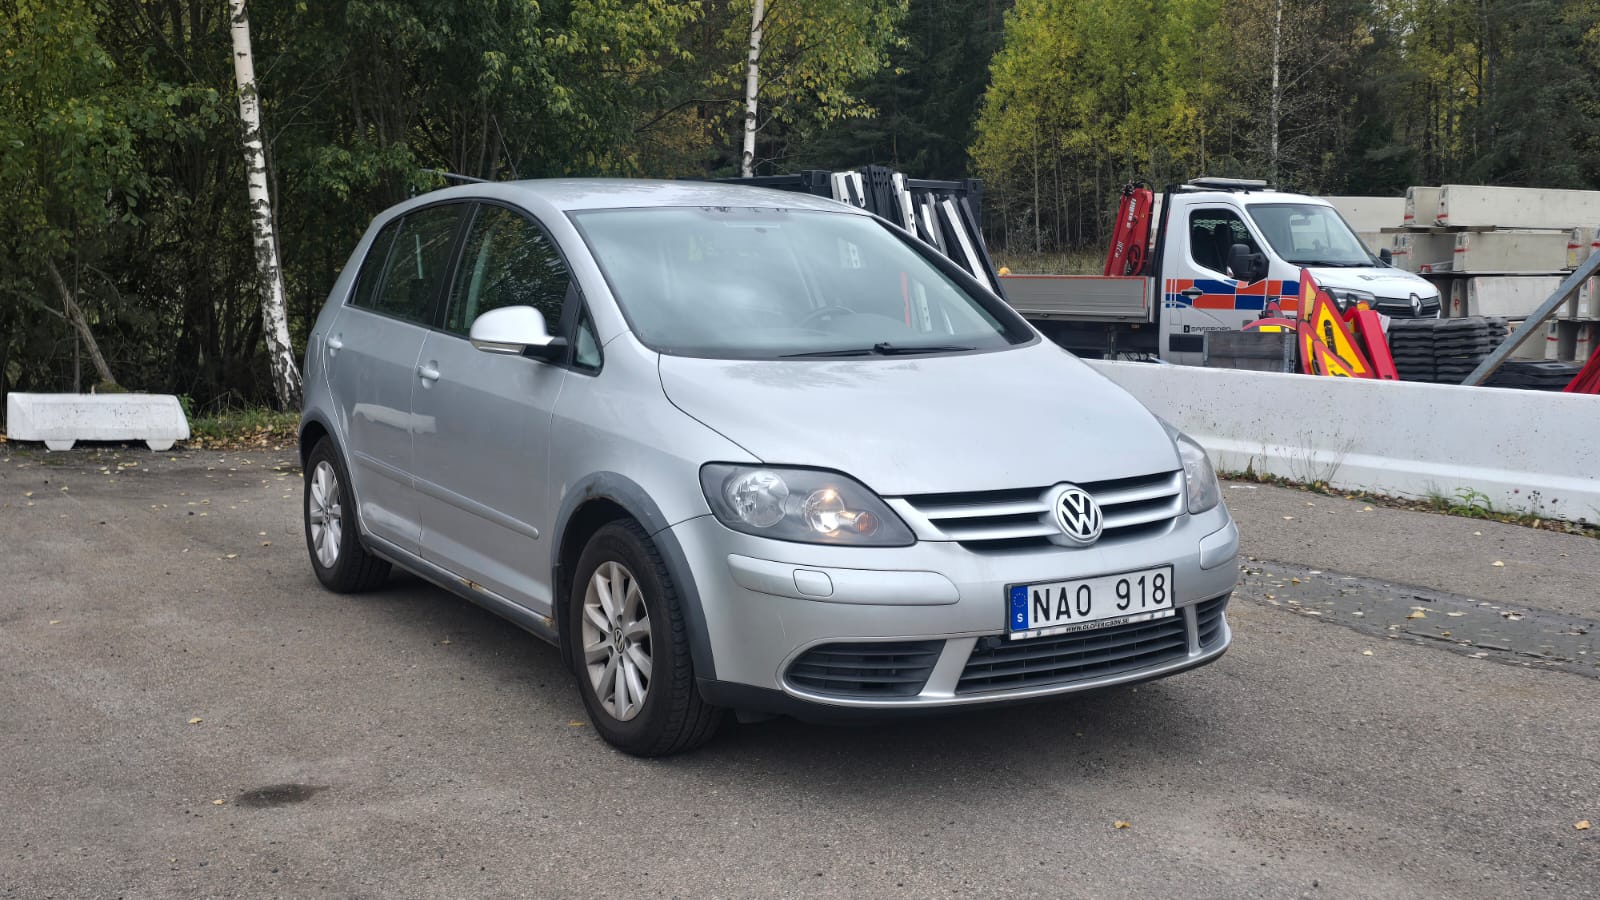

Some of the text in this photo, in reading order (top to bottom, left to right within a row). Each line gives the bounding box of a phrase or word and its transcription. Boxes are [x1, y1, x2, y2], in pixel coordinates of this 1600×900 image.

[1033, 572, 1166, 623] NAO 918
[1017, 613, 1024, 623] S
